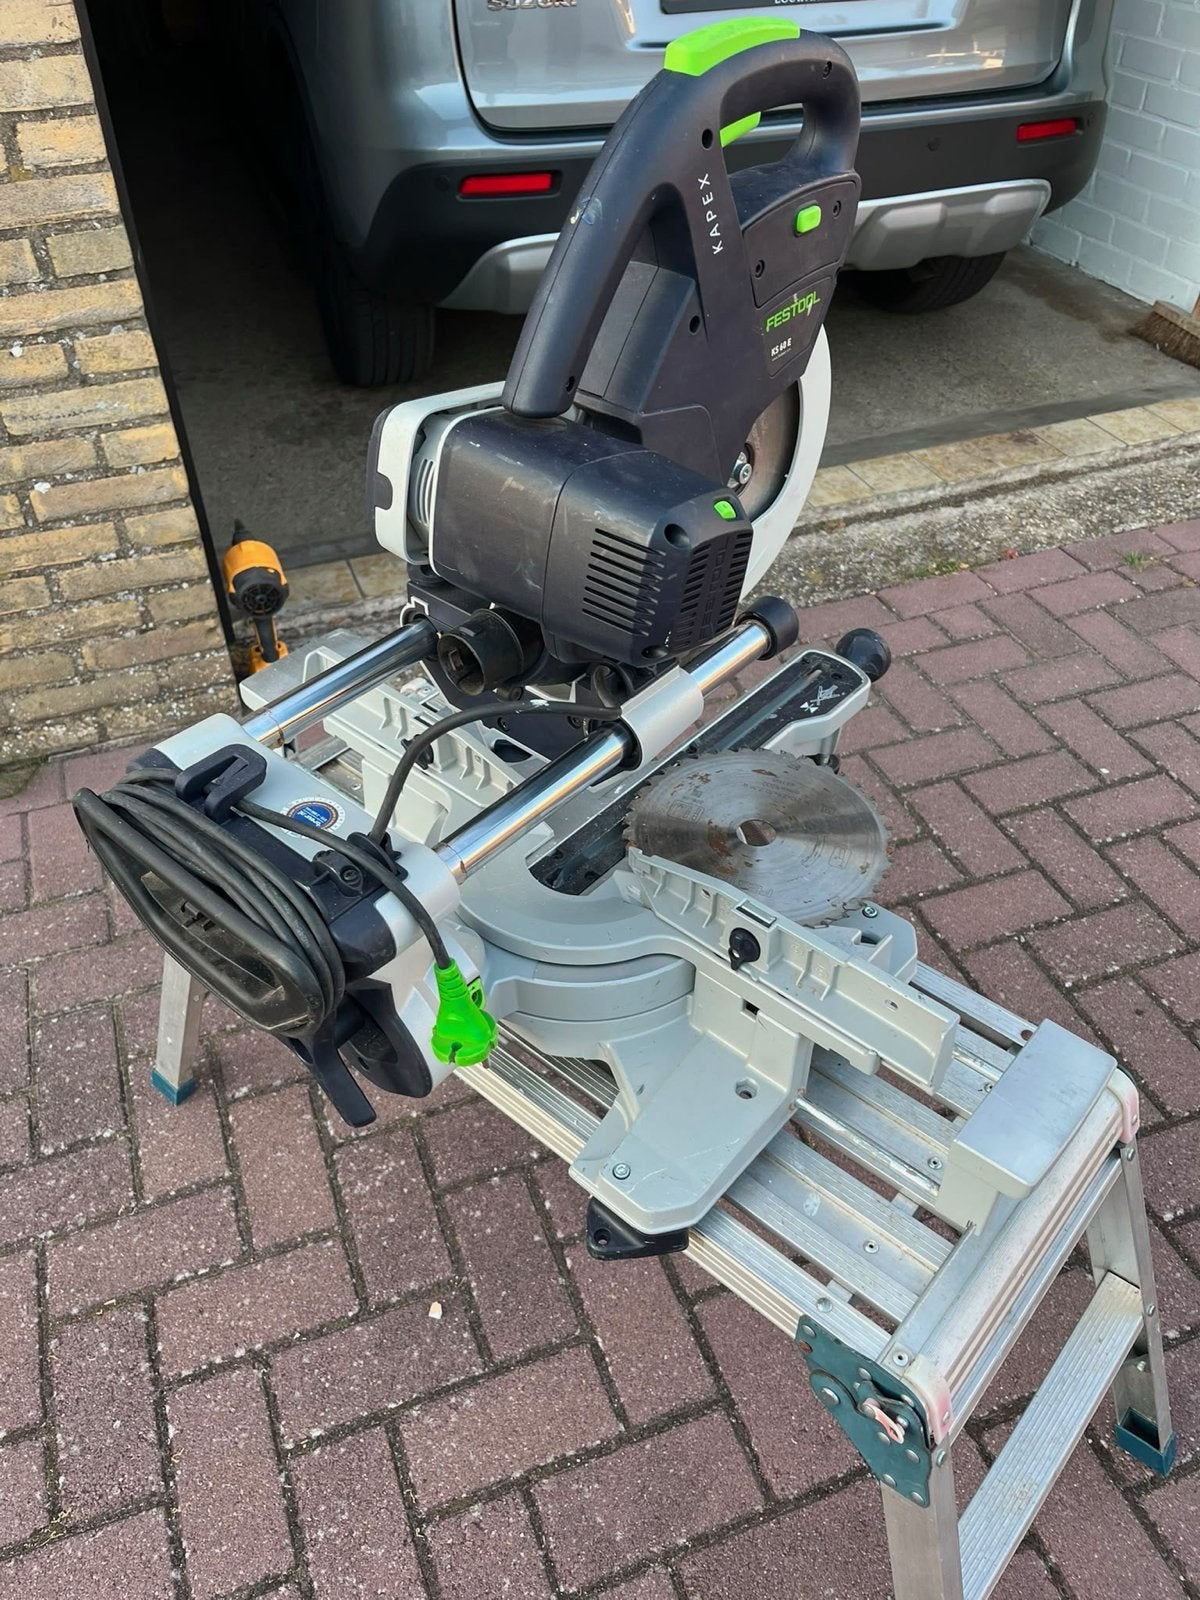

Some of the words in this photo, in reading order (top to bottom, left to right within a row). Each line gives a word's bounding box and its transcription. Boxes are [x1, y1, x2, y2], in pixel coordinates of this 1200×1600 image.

[698, 173, 723, 255] KAPEX
[766, 291, 821, 332] FESTOOL
[787, 337, 792, 347] E
